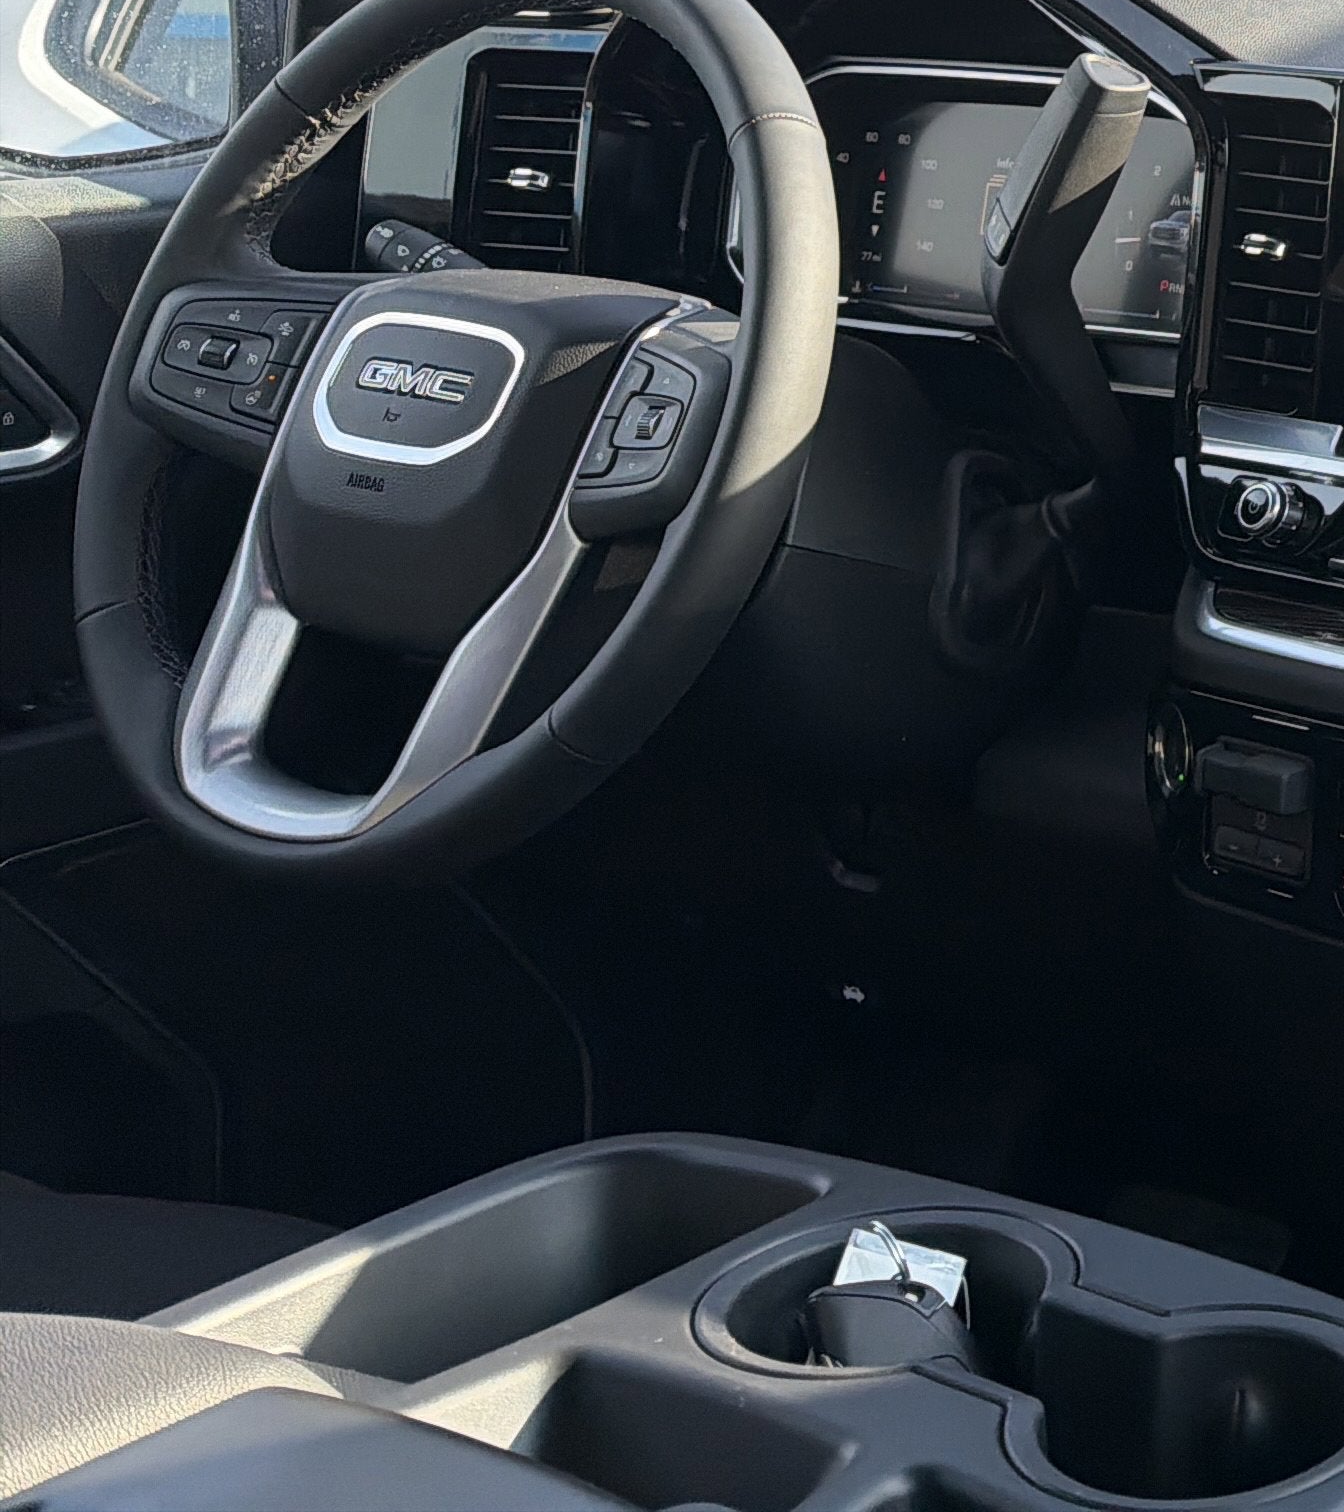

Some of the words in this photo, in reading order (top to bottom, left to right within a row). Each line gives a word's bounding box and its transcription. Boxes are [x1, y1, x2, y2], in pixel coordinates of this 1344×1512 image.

[872, 190, 886, 213] E
[358, 358, 475, 404] GMC
[346, 472, 385, 492] AIRBAG
